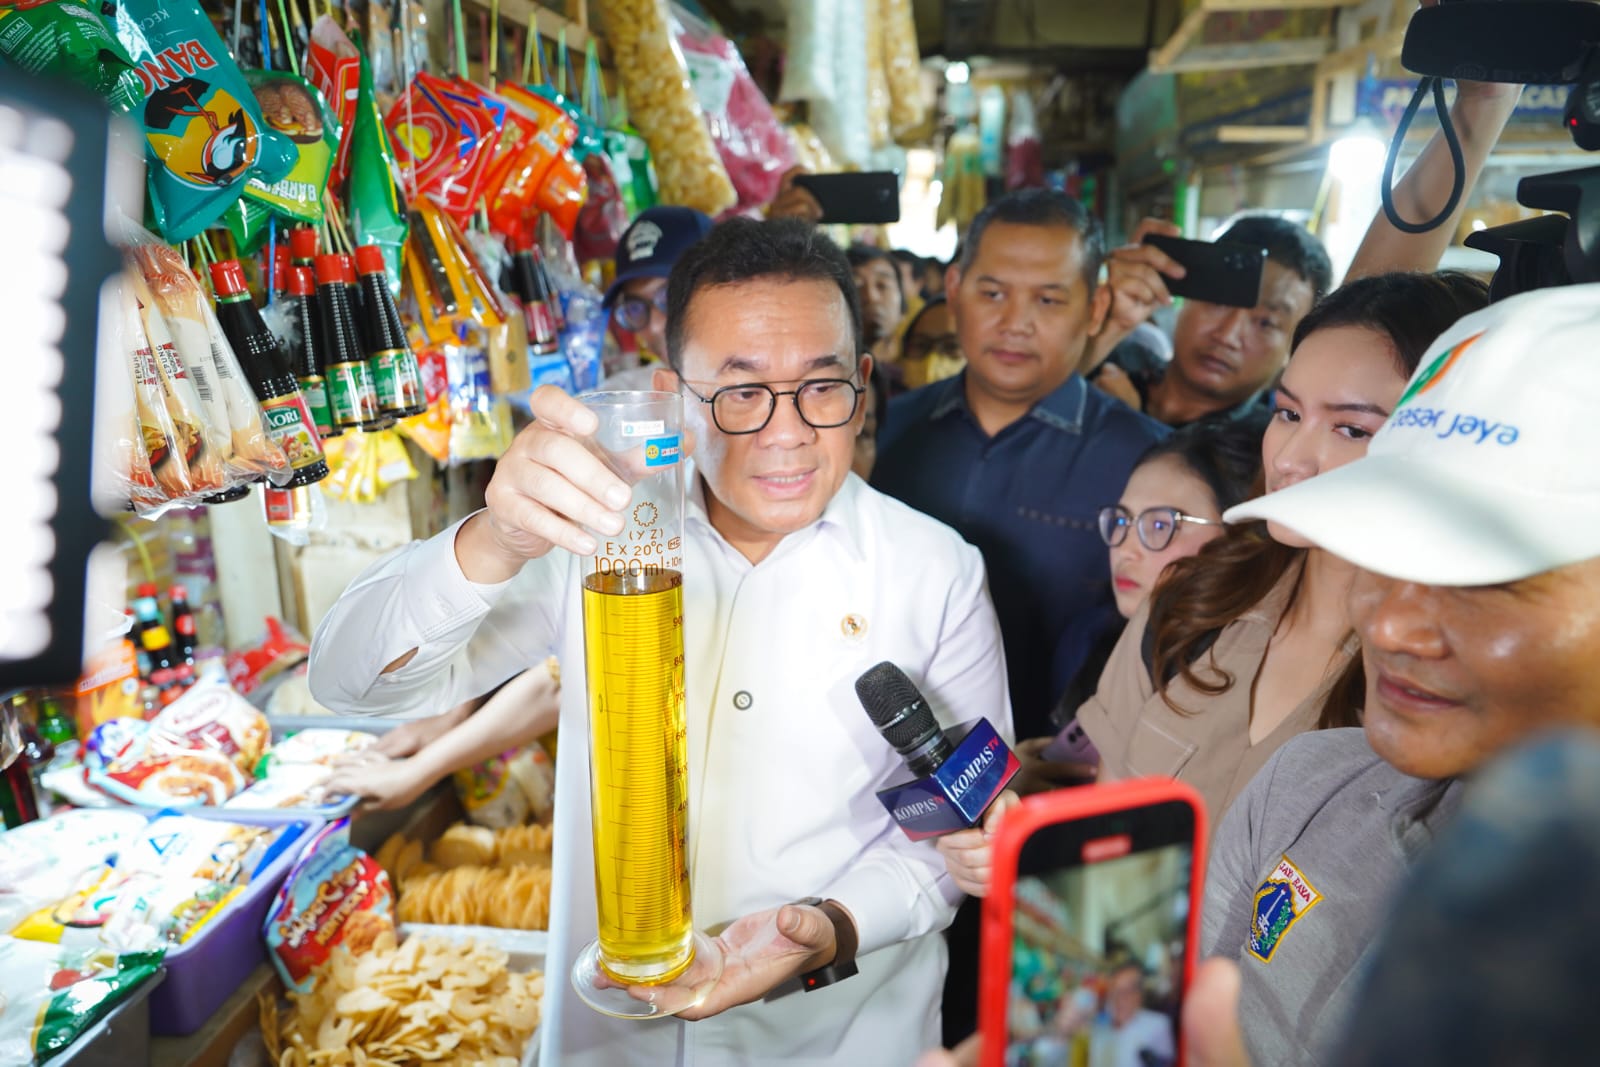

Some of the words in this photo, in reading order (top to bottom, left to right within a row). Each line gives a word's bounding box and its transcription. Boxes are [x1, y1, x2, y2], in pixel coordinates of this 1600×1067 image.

[4, 21, 26, 39] HALAL
[139, 8, 170, 32] KECA
[1436, 413, 1521, 446] jaya
[594, 555, 665, 578] 1000ml
[951, 745, 994, 800] KOMPAS
[893, 798, 938, 821] KOMPAS
